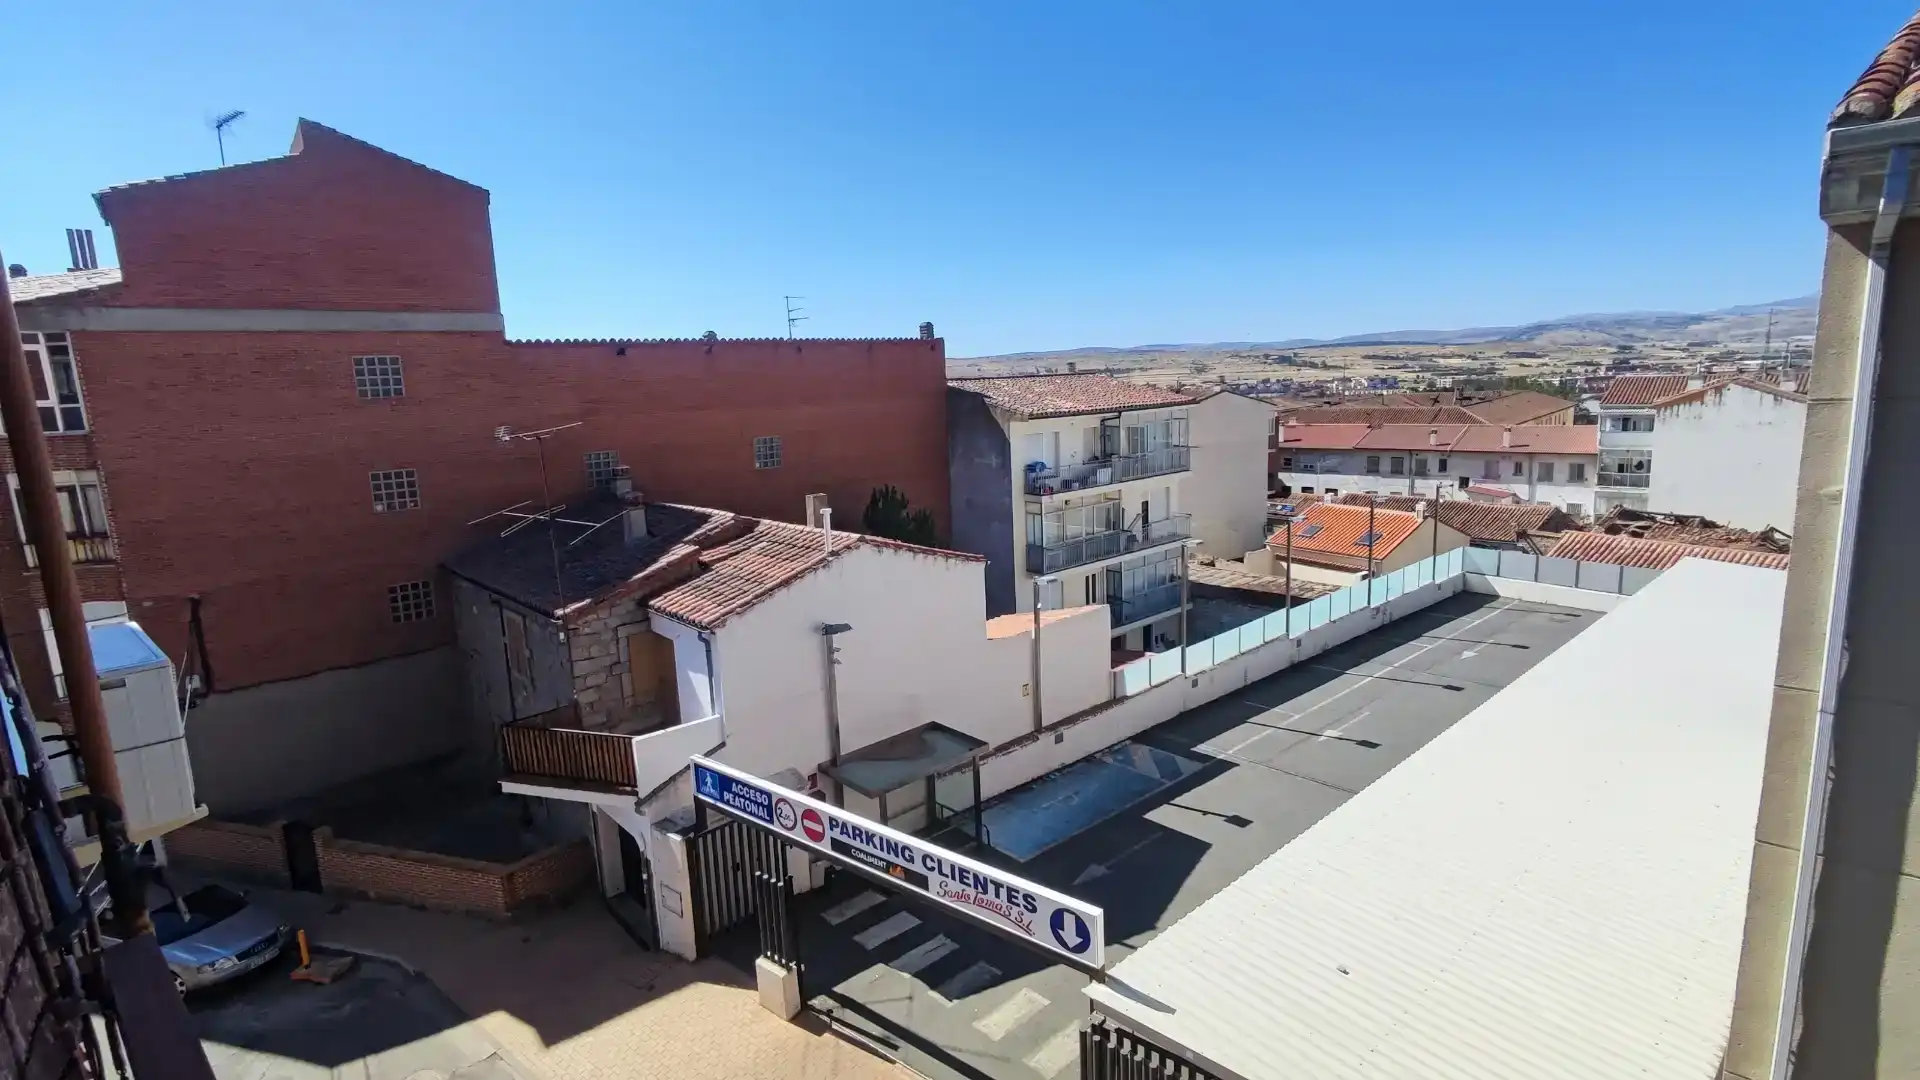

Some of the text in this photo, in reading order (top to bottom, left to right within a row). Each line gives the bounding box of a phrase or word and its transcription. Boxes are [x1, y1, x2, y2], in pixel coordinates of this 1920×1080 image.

[723, 790, 771, 821] PEATONAL
[731, 782, 769, 805] ACCESO
[828, 816, 1038, 914] PARKING CLIENTES
[937, 880, 971, 902] Santo
